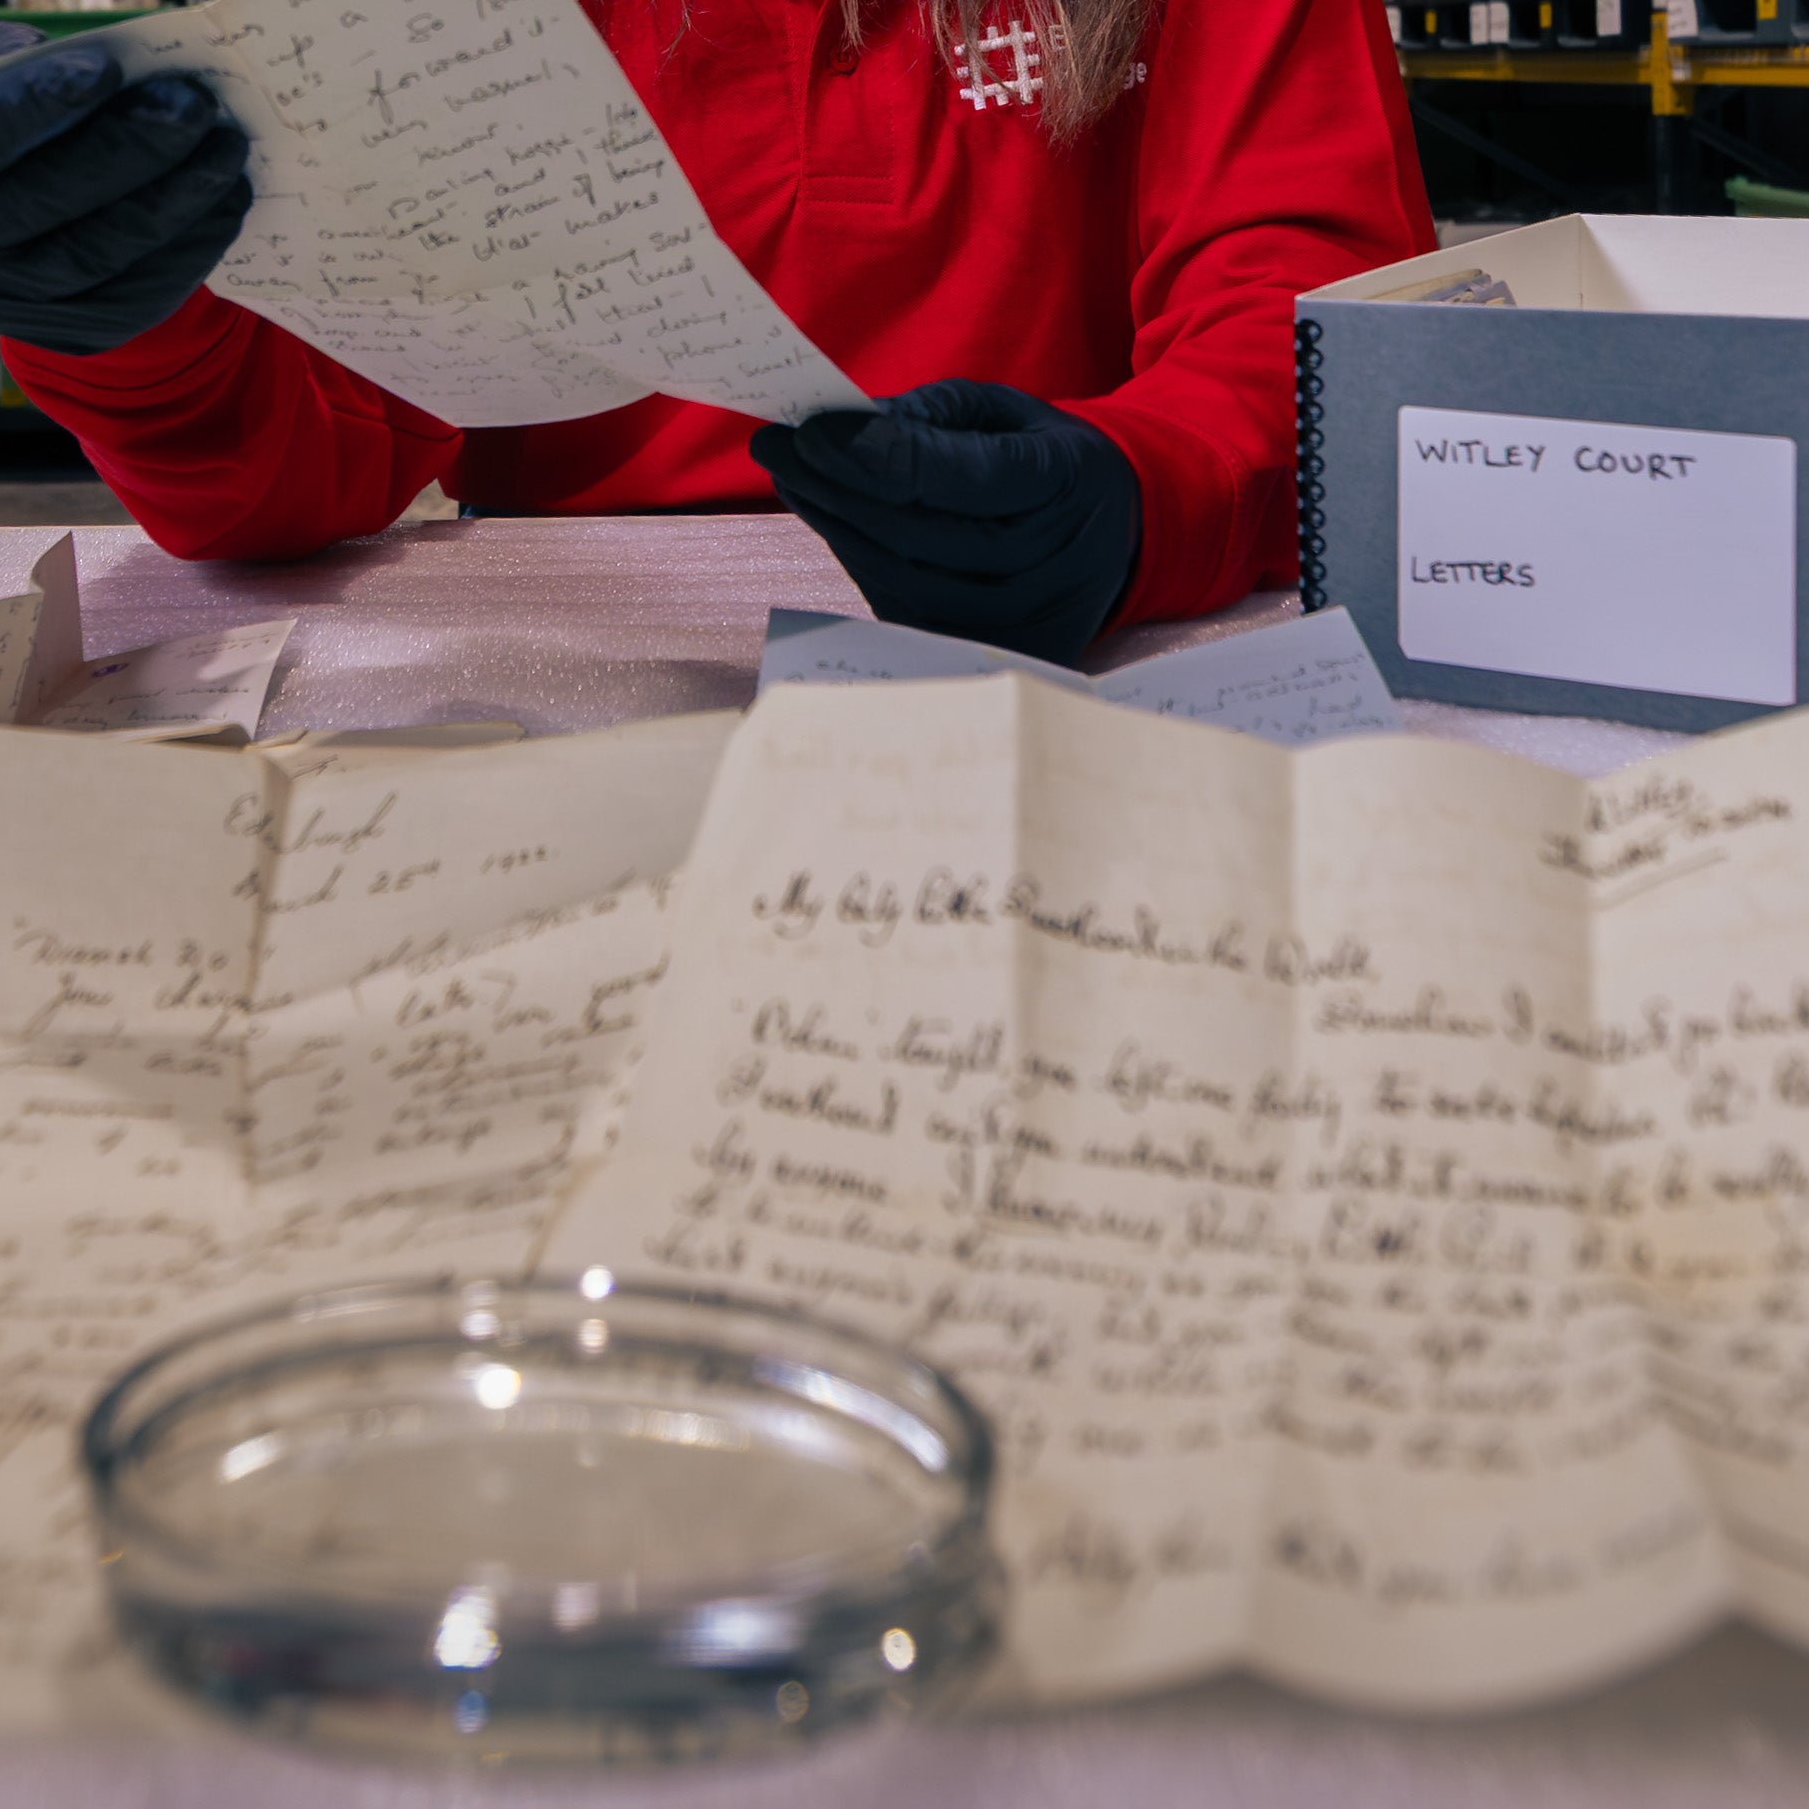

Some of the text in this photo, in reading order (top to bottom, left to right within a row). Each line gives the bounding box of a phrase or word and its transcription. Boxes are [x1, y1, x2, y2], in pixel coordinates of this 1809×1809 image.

[1414, 437, 1697, 481] WITLEY COURT
[1411, 555, 1536, 588] LETTERS
